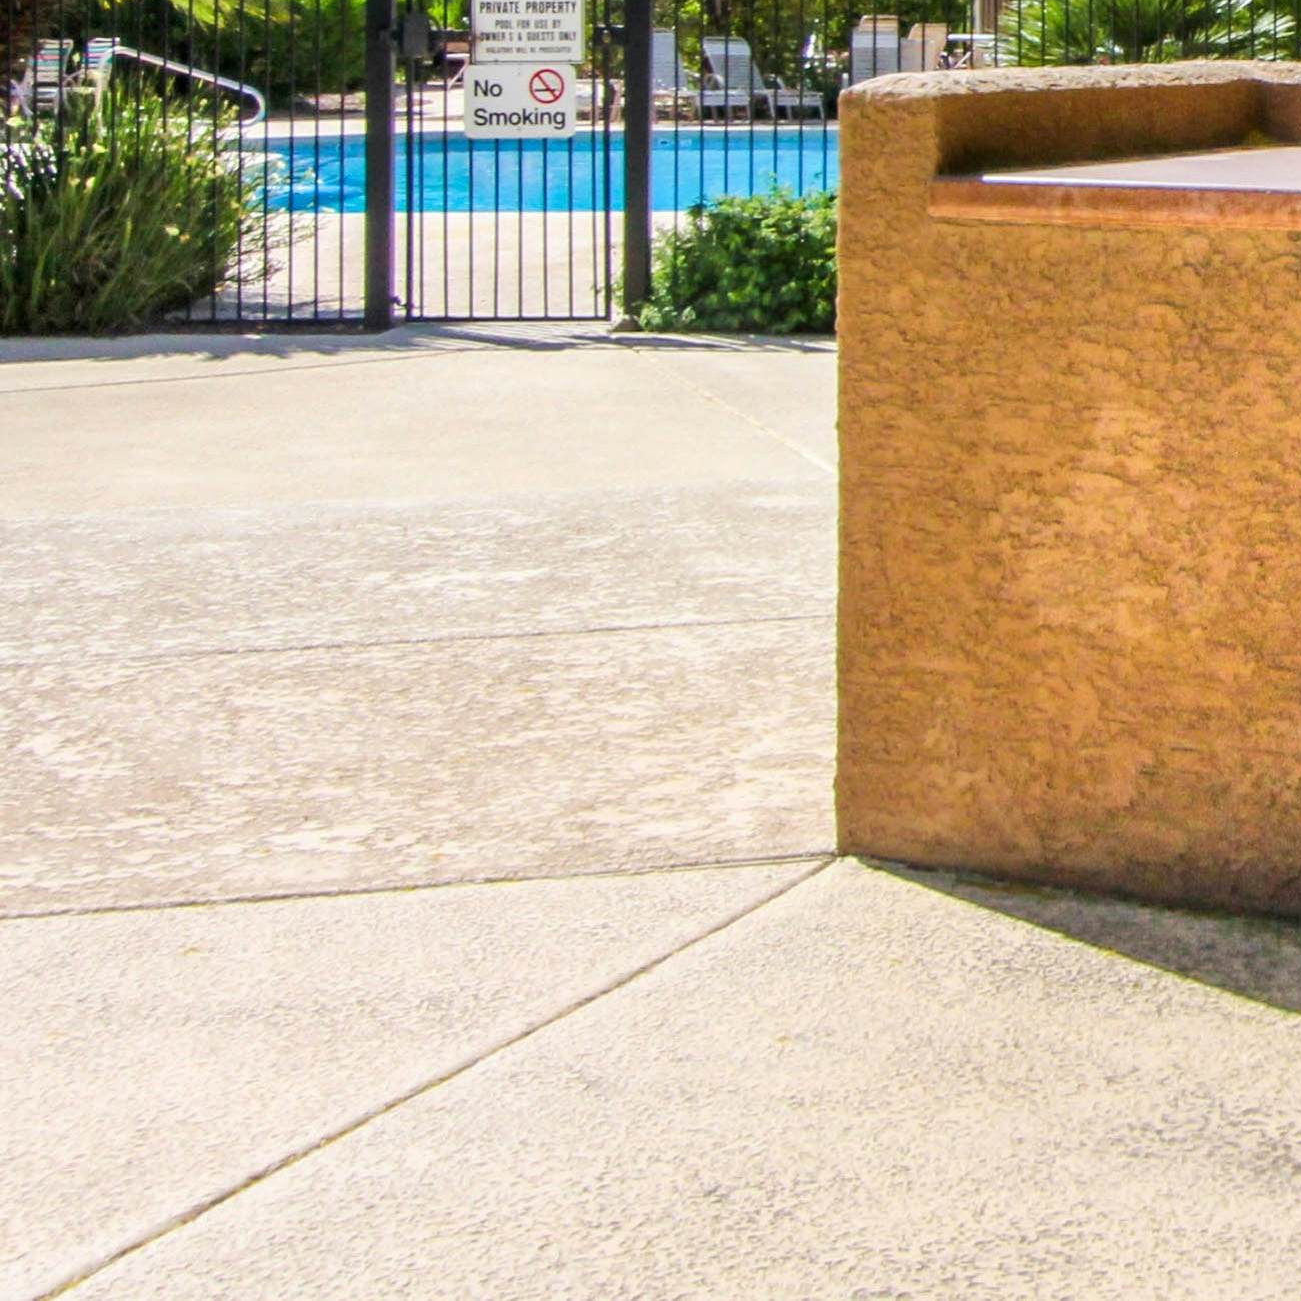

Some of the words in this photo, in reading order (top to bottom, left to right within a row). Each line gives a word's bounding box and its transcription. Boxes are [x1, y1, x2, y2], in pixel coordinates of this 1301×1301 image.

[479, 1, 520, 14] PRIVATE
[525, 1, 577, 14] PROPERTY
[495, 19, 513, 30] POOL
[517, 19, 530, 30] FOR
[534, 19, 548, 30] USE
[526, 31, 554, 42] GUESTS
[559, 31, 577, 42] ONLY
[474, 80, 503, 97] No
[473, 107, 566, 130] Smoking
